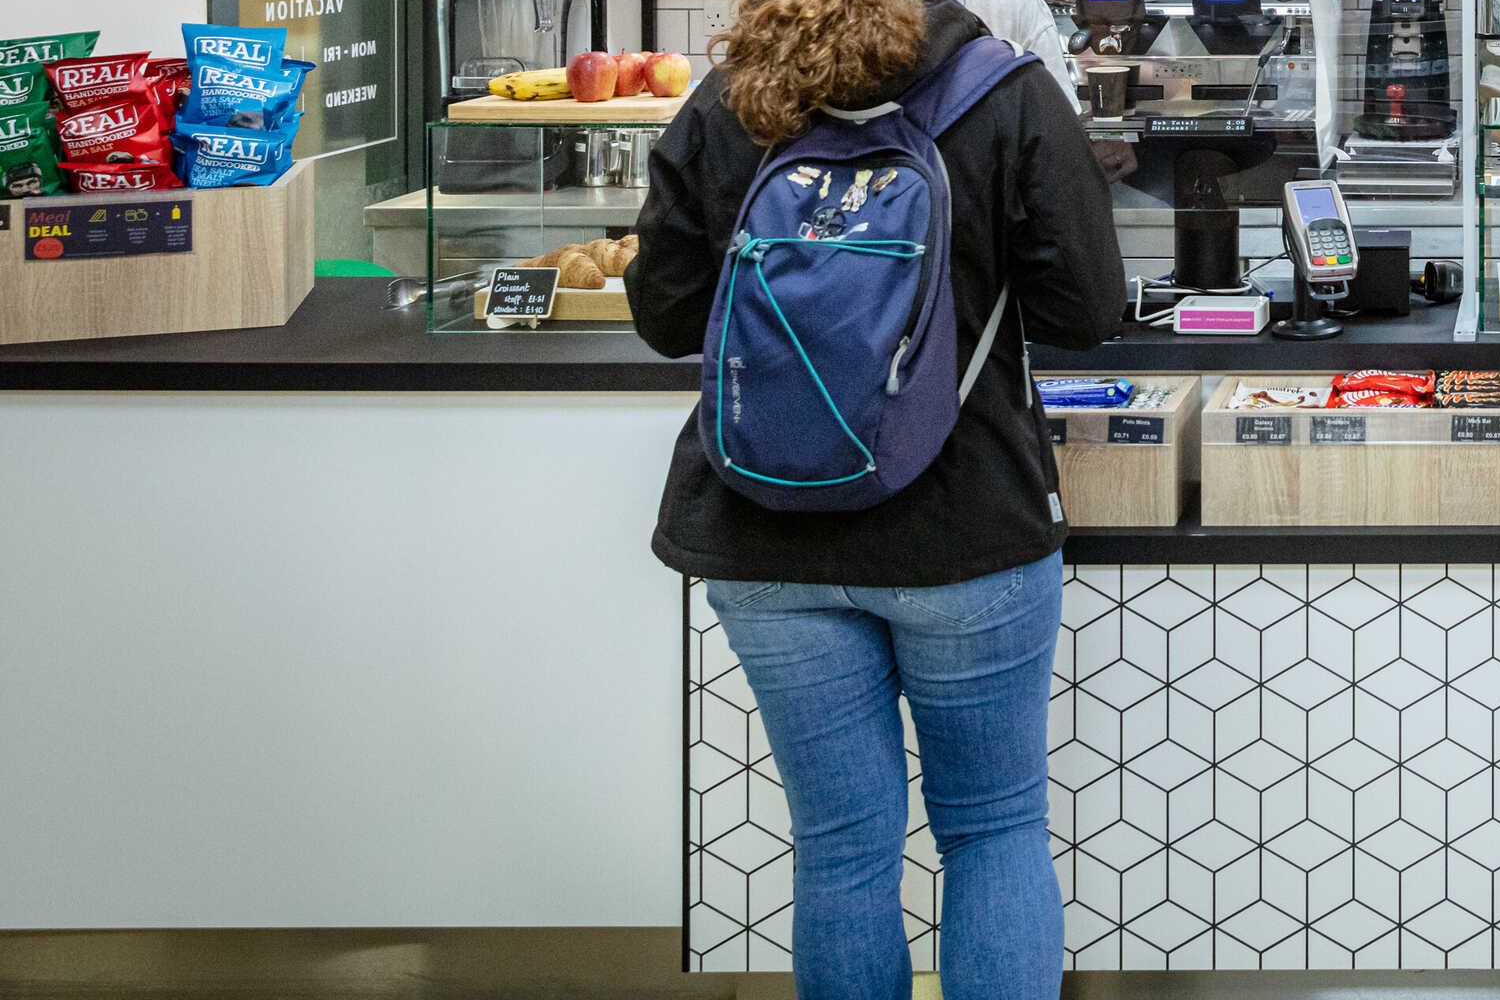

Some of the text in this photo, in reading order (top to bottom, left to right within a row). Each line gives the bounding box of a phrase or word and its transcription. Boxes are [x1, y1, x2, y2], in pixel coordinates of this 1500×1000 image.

[0, 44, 59, 67] EAL
[200, 39, 266, 63] REAL
[62, 63, 129, 89] REAL
[205, 68, 271, 93] REAL
[65, 86, 129, 101] HANDCOOKED
[201, 89, 267, 103] HANDCOOKED
[64, 109, 134, 137] REAL
[67, 128, 137, 149] HANDCOOKED
[91, 143, 114, 154] SALT
[197, 137, 263, 161] REAL
[83, 173, 150, 190] REAL
[29, 209, 72, 224] Meal
[29, 225, 72, 238] DEAL
[498, 271, 520, 281] Plain
[494, 282, 530, 293] Croissant
